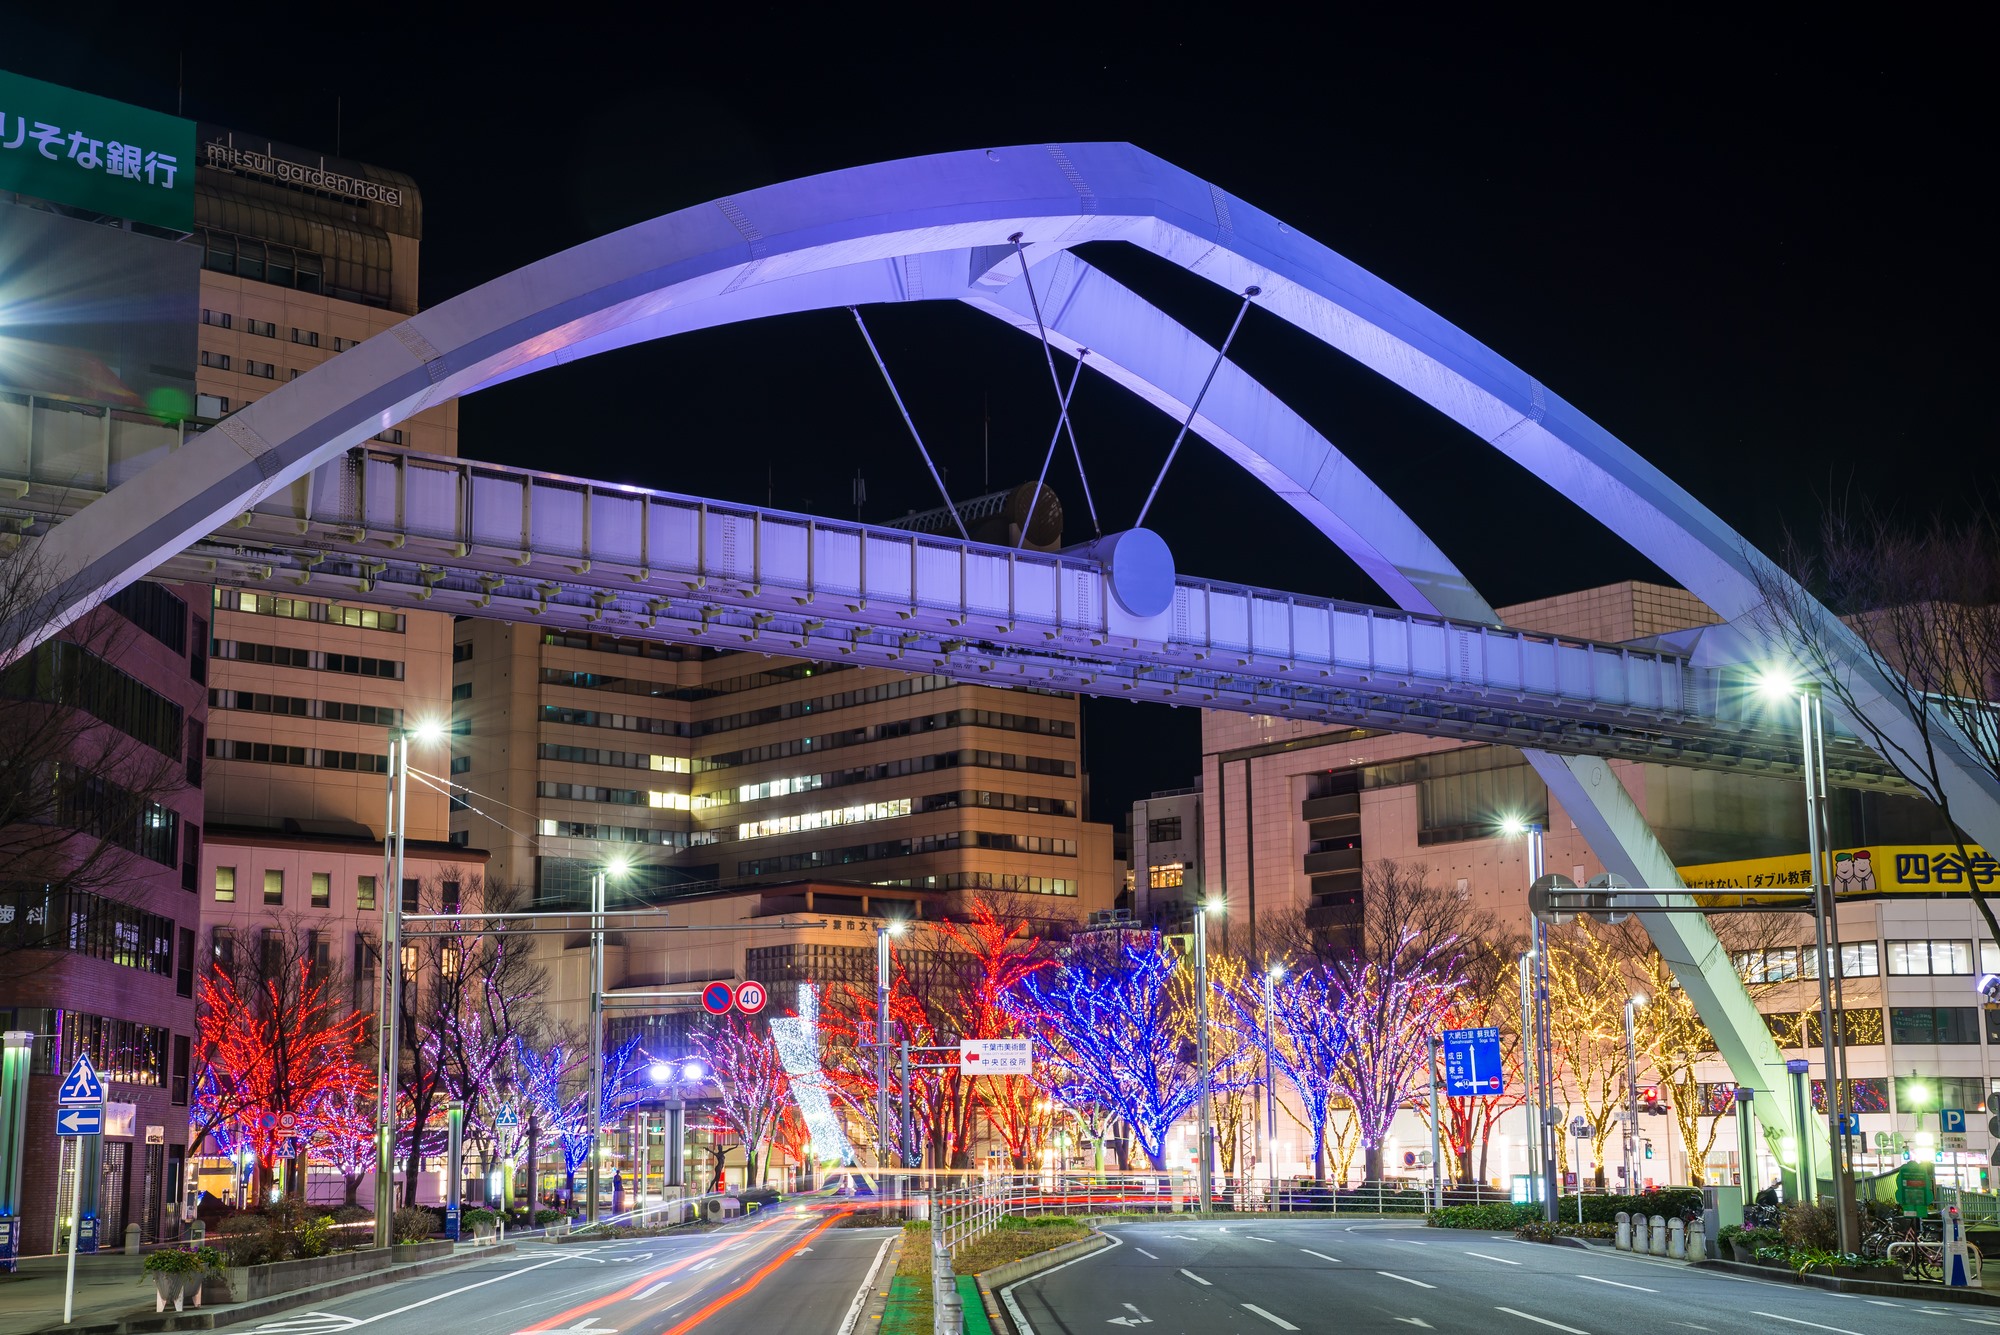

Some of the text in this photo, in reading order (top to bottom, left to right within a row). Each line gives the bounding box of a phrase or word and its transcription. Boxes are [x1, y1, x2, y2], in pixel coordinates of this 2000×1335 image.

[0, 112, 177, 189] りそな銀行
[207, 132, 271, 174] mitsui
[742, 990, 759, 1004] 40
[981, 1043, 1026, 1051] 千葉市美術館
[981, 1058, 1026, 1066] 中央区役所
[282, 1117, 293, 1125] 30
[1947, 1111, 1961, 1130] P
